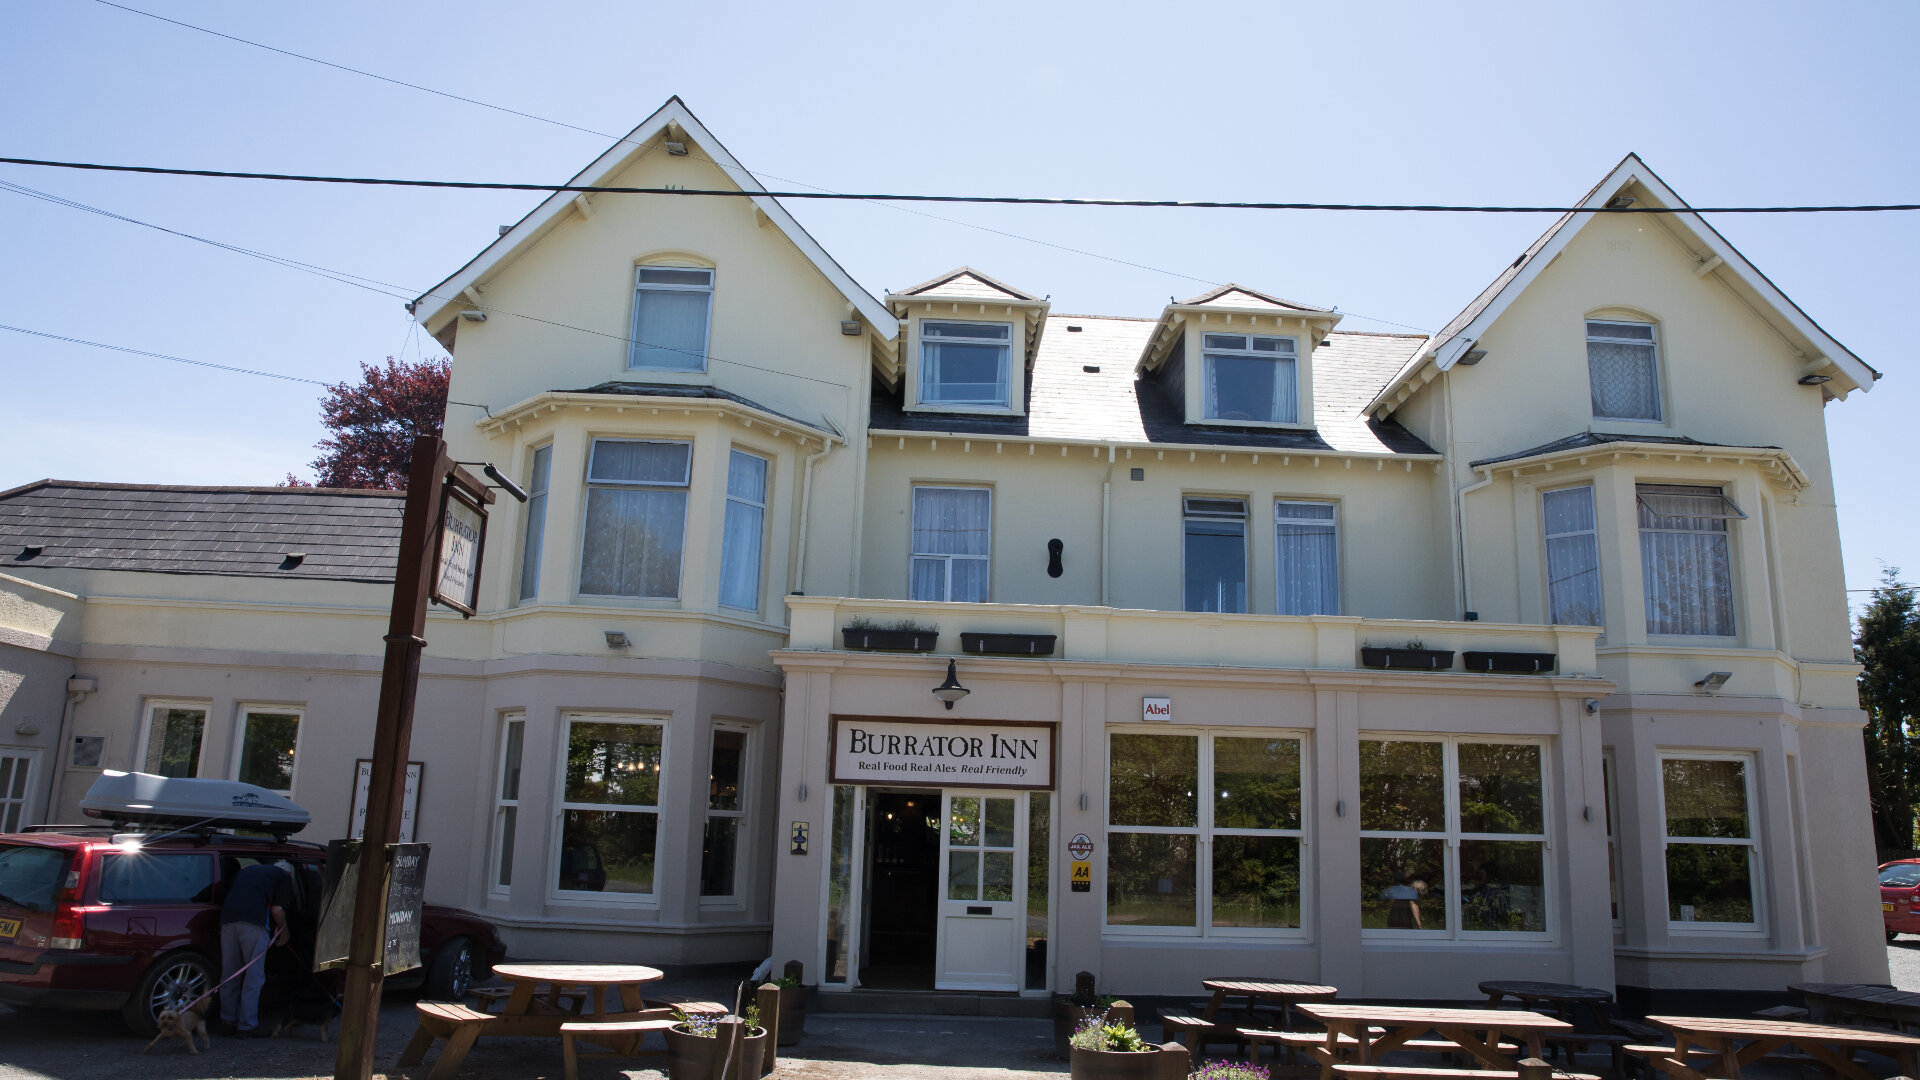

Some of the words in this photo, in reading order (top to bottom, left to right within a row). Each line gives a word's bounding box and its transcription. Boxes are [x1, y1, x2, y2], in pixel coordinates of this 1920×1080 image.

[451, 535, 464, 556] INN
[1145, 703, 1170, 715] Abel
[849, 728, 983, 758] BURRATOR
[990, 733, 1039, 760] INN
[858, 761, 881, 771] Real
[883, 761, 908, 772] Food
[910, 762, 932, 773] Real
[934, 763, 957, 773] Ales
[961, 764, 984, 774] Real
[985, 765, 1028, 778] Friendly
[396, 856, 420, 867] SUNDAY
[1074, 866, 1089, 878] AA
[389, 911, 412, 924] MONDAY
